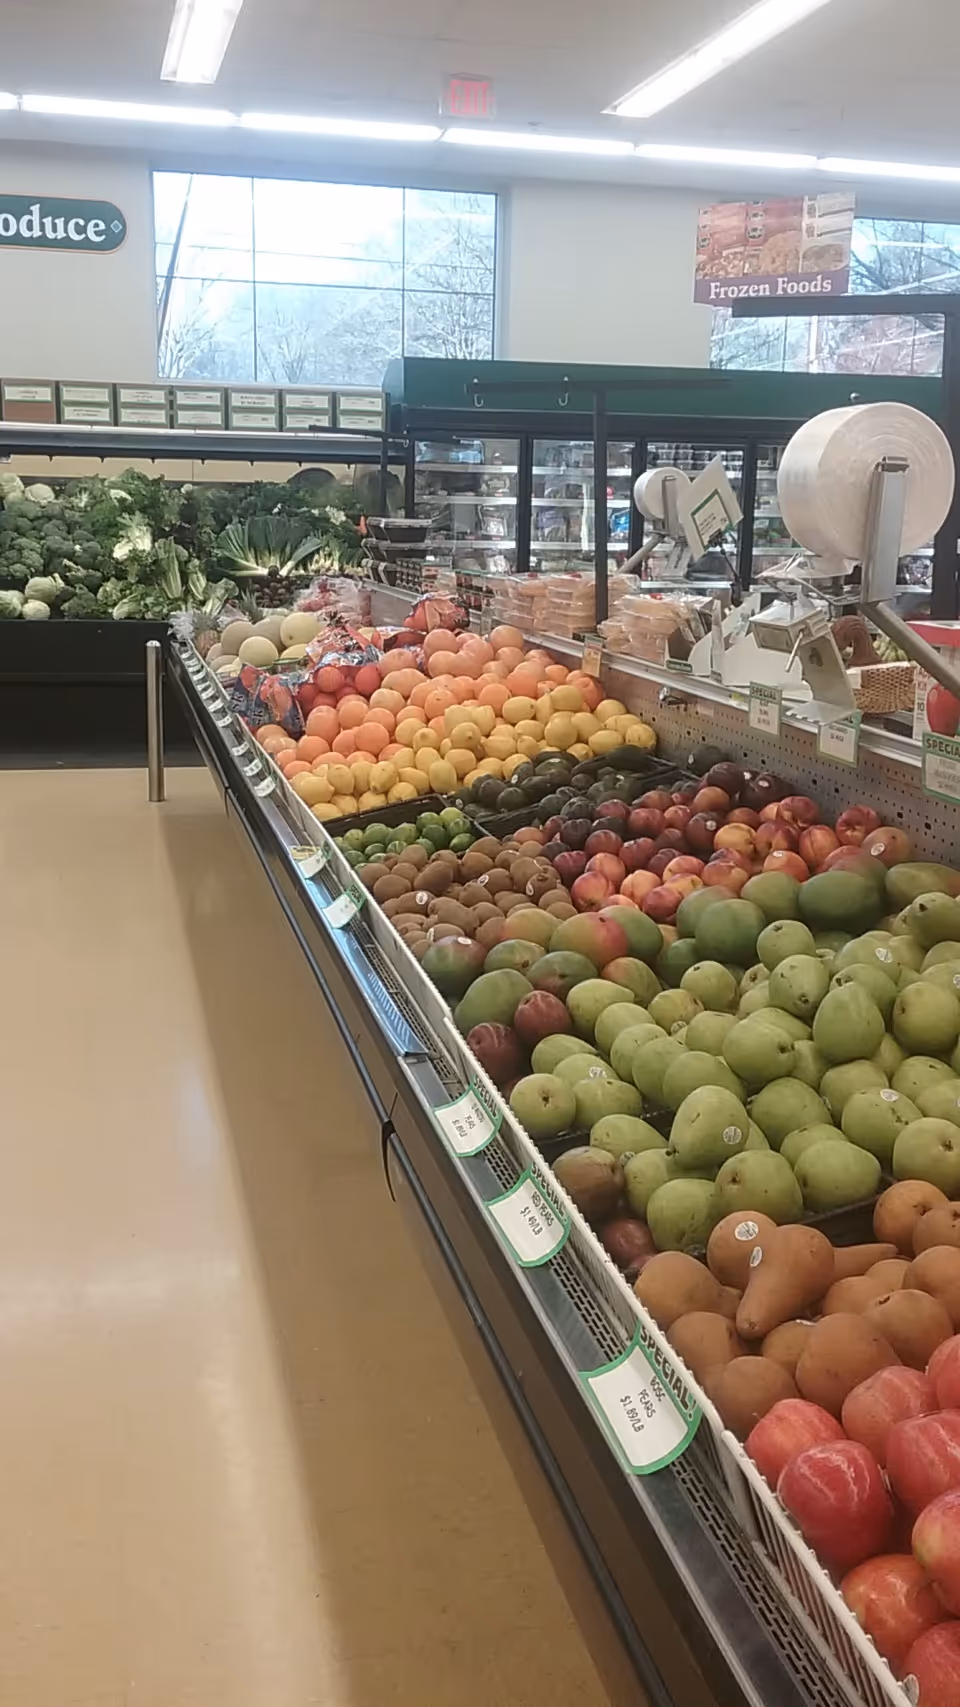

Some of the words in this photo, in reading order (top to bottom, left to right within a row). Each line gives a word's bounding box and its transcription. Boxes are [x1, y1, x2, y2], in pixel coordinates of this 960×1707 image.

[709, 282, 770, 300] Frozen
[776, 275, 832, 295] Foods
[532, 1191, 542, 1208] RED
[539, 1203, 554, 1227] PEARS
[640, 1325, 697, 1420] SPECIAL!
[649, 1375, 665, 1402] BOSC
[619, 1395, 645, 1433] $1.89/LB
[638, 1389, 656, 1419] PEARS
